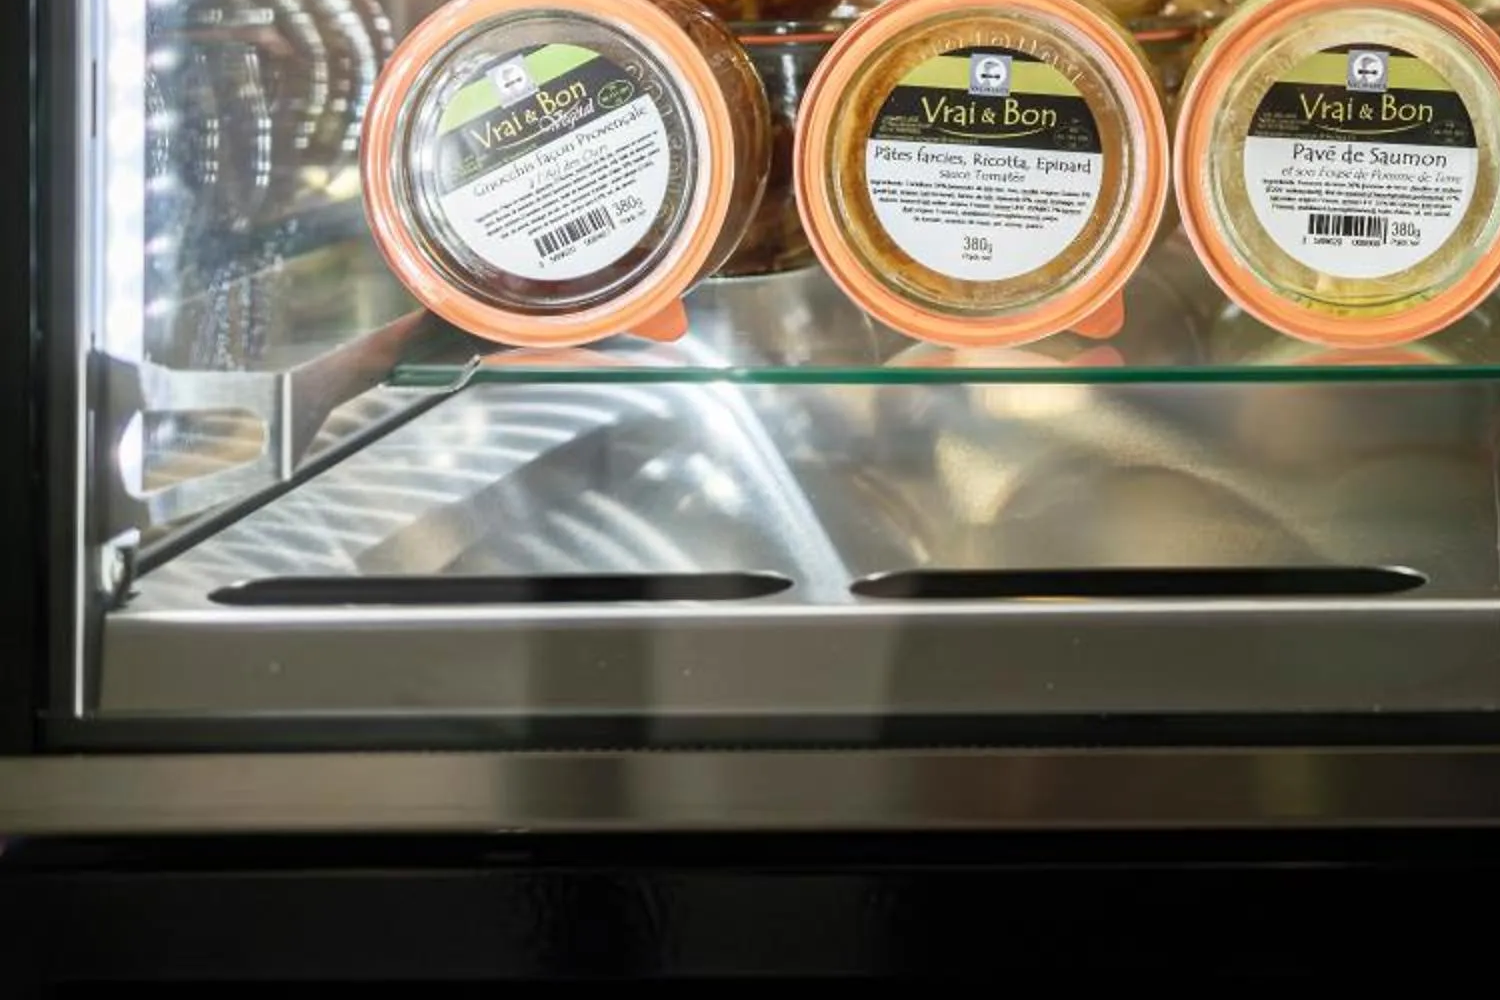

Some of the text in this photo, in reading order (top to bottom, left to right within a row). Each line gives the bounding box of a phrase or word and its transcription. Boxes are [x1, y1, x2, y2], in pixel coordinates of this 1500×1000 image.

[471, 115, 524, 150] Vrai
[525, 109, 539, 125] &
[535, 80, 588, 115] Bon
[921, 96, 1057, 127] Vrai & Bon
[1300, 92, 1434, 123] Vrai & Bon
[874, 145, 913, 161] Pâtes
[917, 146, 967, 167] farcies,
[973, 151, 1031, 171] Ricotta,
[1293, 143, 1448, 169] Pavé de Saumon
[1391, 221, 1421, 238] 380g
[963, 235, 993, 253] 380g
